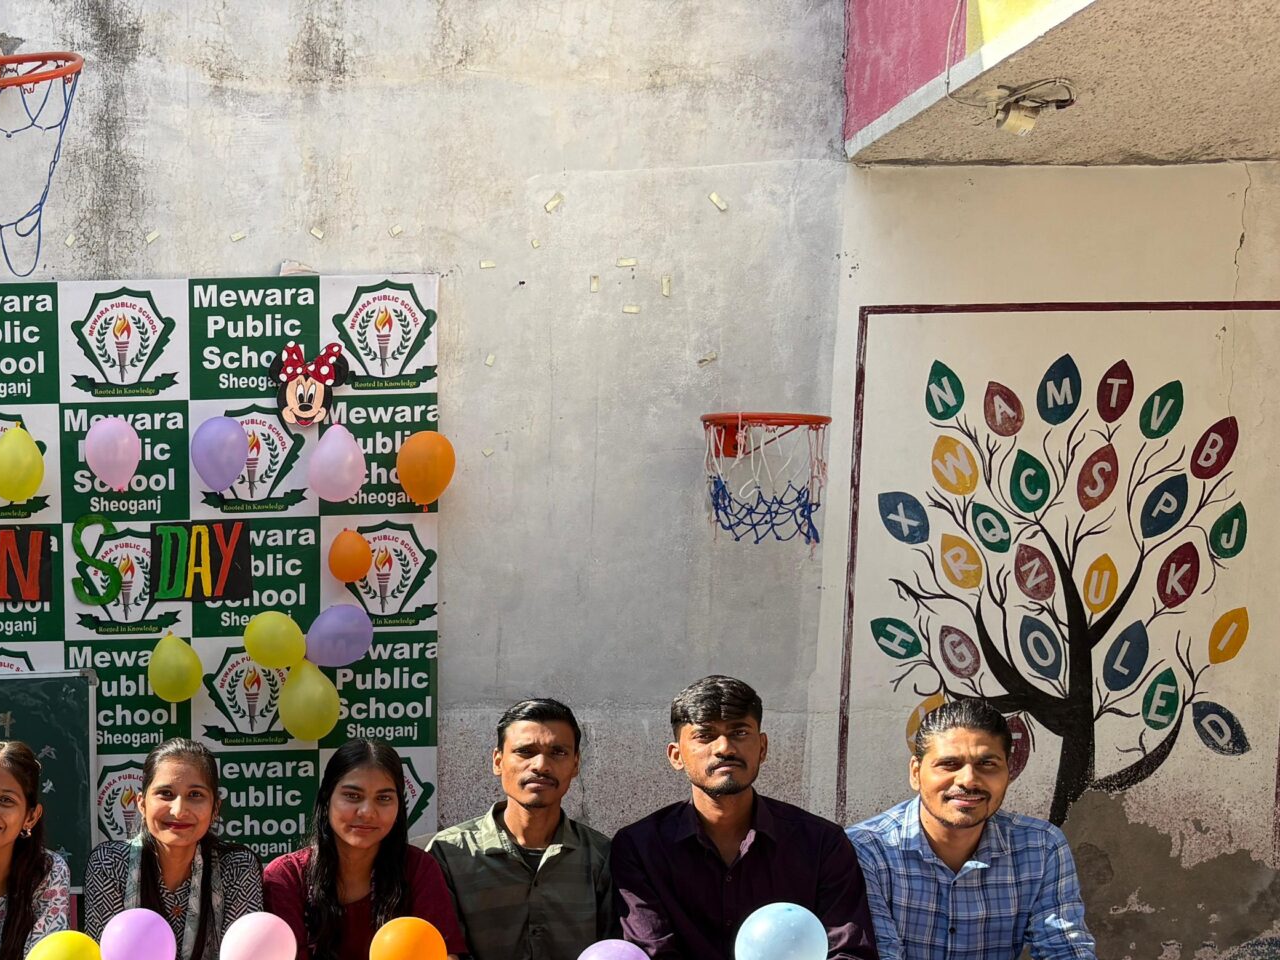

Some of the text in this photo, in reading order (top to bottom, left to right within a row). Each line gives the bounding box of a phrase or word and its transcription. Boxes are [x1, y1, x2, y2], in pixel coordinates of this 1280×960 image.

[194, 285, 314, 307] Mewara
[88, 302, 157, 337] MEWARA PUBLIC SCHOOL
[208, 315, 301, 338] Public
[350, 295, 419, 330] MEWARA PUBLIC SCHOOL
[124, 386, 156, 395] Knowledge
[384, 379, 416, 387] Knowledge
[929, 377, 957, 413] N
[1046, 378, 1073, 408] M
[1107, 378, 1127, 408] T
[994, 396, 1016, 425] A
[1150, 396, 1172, 430] V
[240, 419, 285, 452] PUBLIC SCHOOL
[1198, 433, 1224, 468] B
[933, 445, 973, 485] W
[1084, 462, 1111, 498] S
[1021, 468, 1043, 501] C
[90, 496, 161, 513] Sheoganj
[253, 502, 284, 511] Knowledge
[888, 503, 920, 536] X
[1153, 492, 1178, 518] P
[977, 512, 1008, 542] Q
[1221, 518, 1239, 548] J
[72, 514, 121, 606] S
[154, 522, 242, 599] DAY
[115, 543, 141, 552] PUBLIC
[372, 534, 419, 567] PUBLIC SCHOOL
[251, 554, 302, 577] blic
[943, 547, 980, 580] R
[1021, 559, 1049, 589] Z
[1166, 562, 1191, 595] K
[1091, 571, 1109, 603] U
[98, 625, 120, 633] Rooted
[128, 624, 159, 632] Knowledge
[385, 616, 415, 625] Knowledge
[878, 625, 915, 654] H
[1027, 630, 1055, 667] O
[1217, 622, 1240, 650] I
[947, 638, 971, 669] G
[1112, 640, 1132, 676] L
[219, 661, 241, 689] MEWARA
[337, 667, 429, 690] Public
[97, 703, 176, 725] chool
[1147, 683, 1176, 722] E
[346, 724, 417, 740] Sheoganj
[1200, 714, 1231, 746] D
[96, 776, 117, 807] MEWARA
